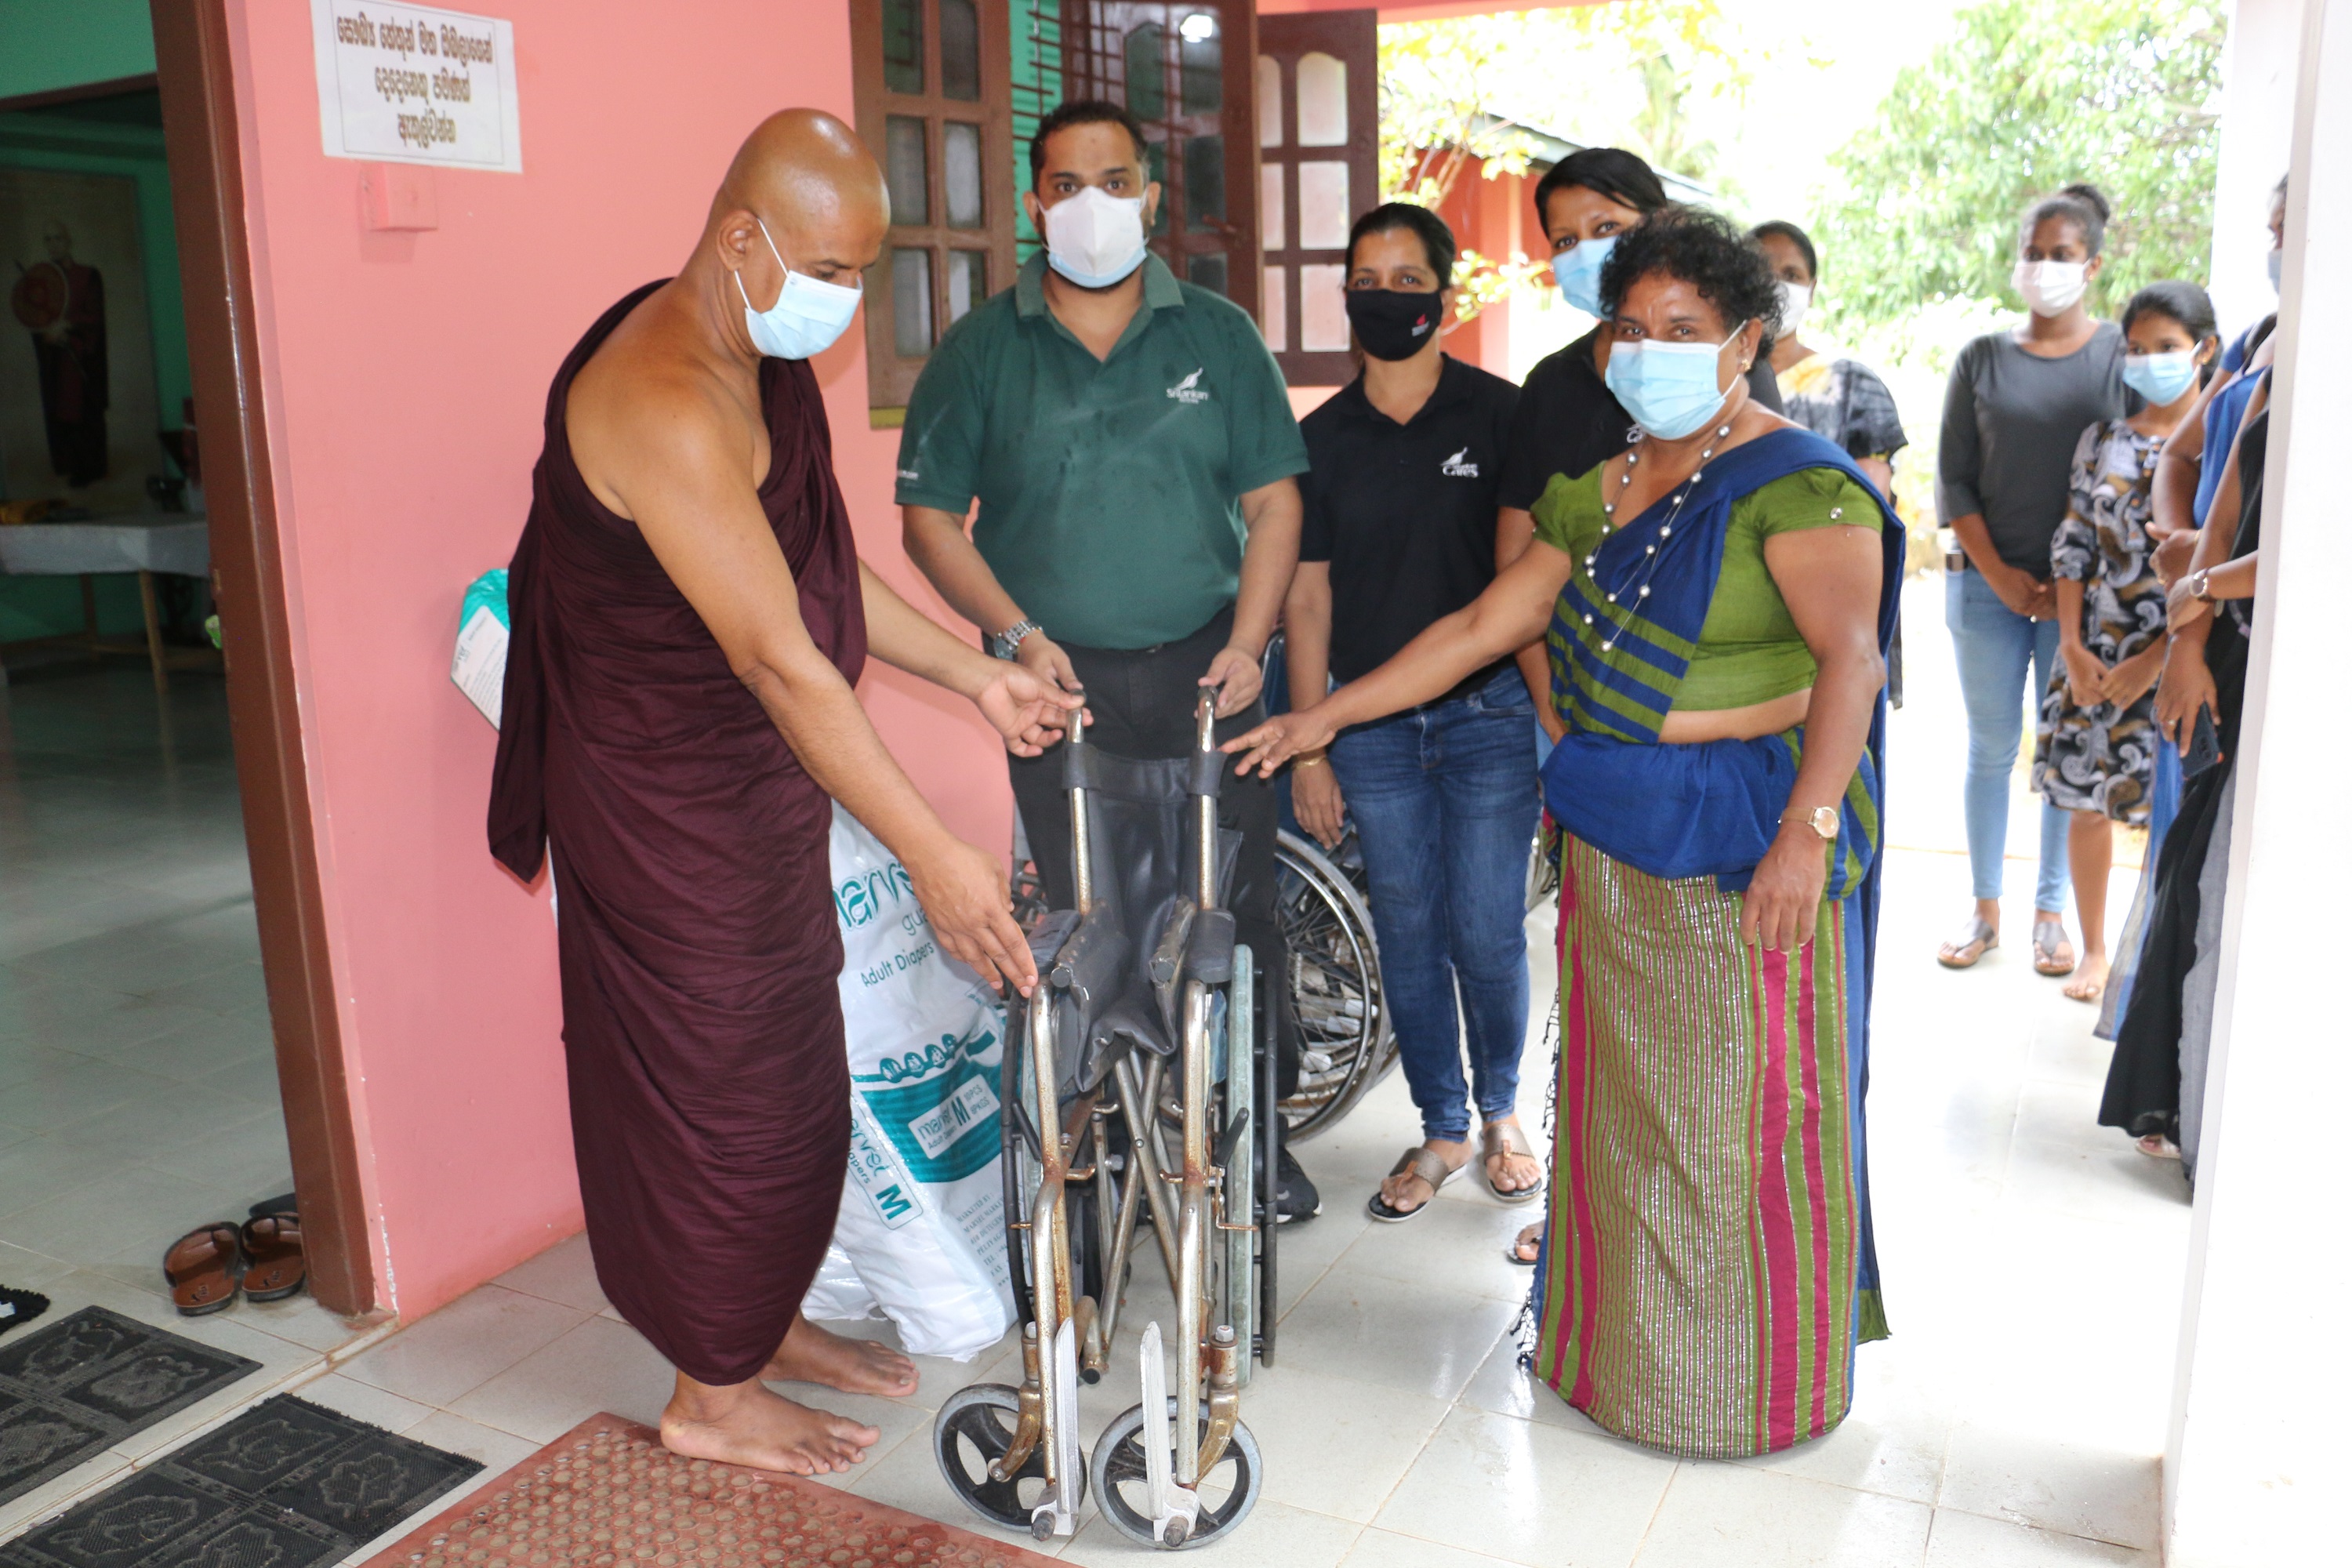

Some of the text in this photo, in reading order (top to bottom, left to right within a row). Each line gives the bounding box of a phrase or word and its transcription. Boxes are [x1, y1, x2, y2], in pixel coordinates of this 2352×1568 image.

[861, 942, 935, 987] Adult Diapers
[951, 1095, 971, 1127] M
[875, 1183, 913, 1220] M
